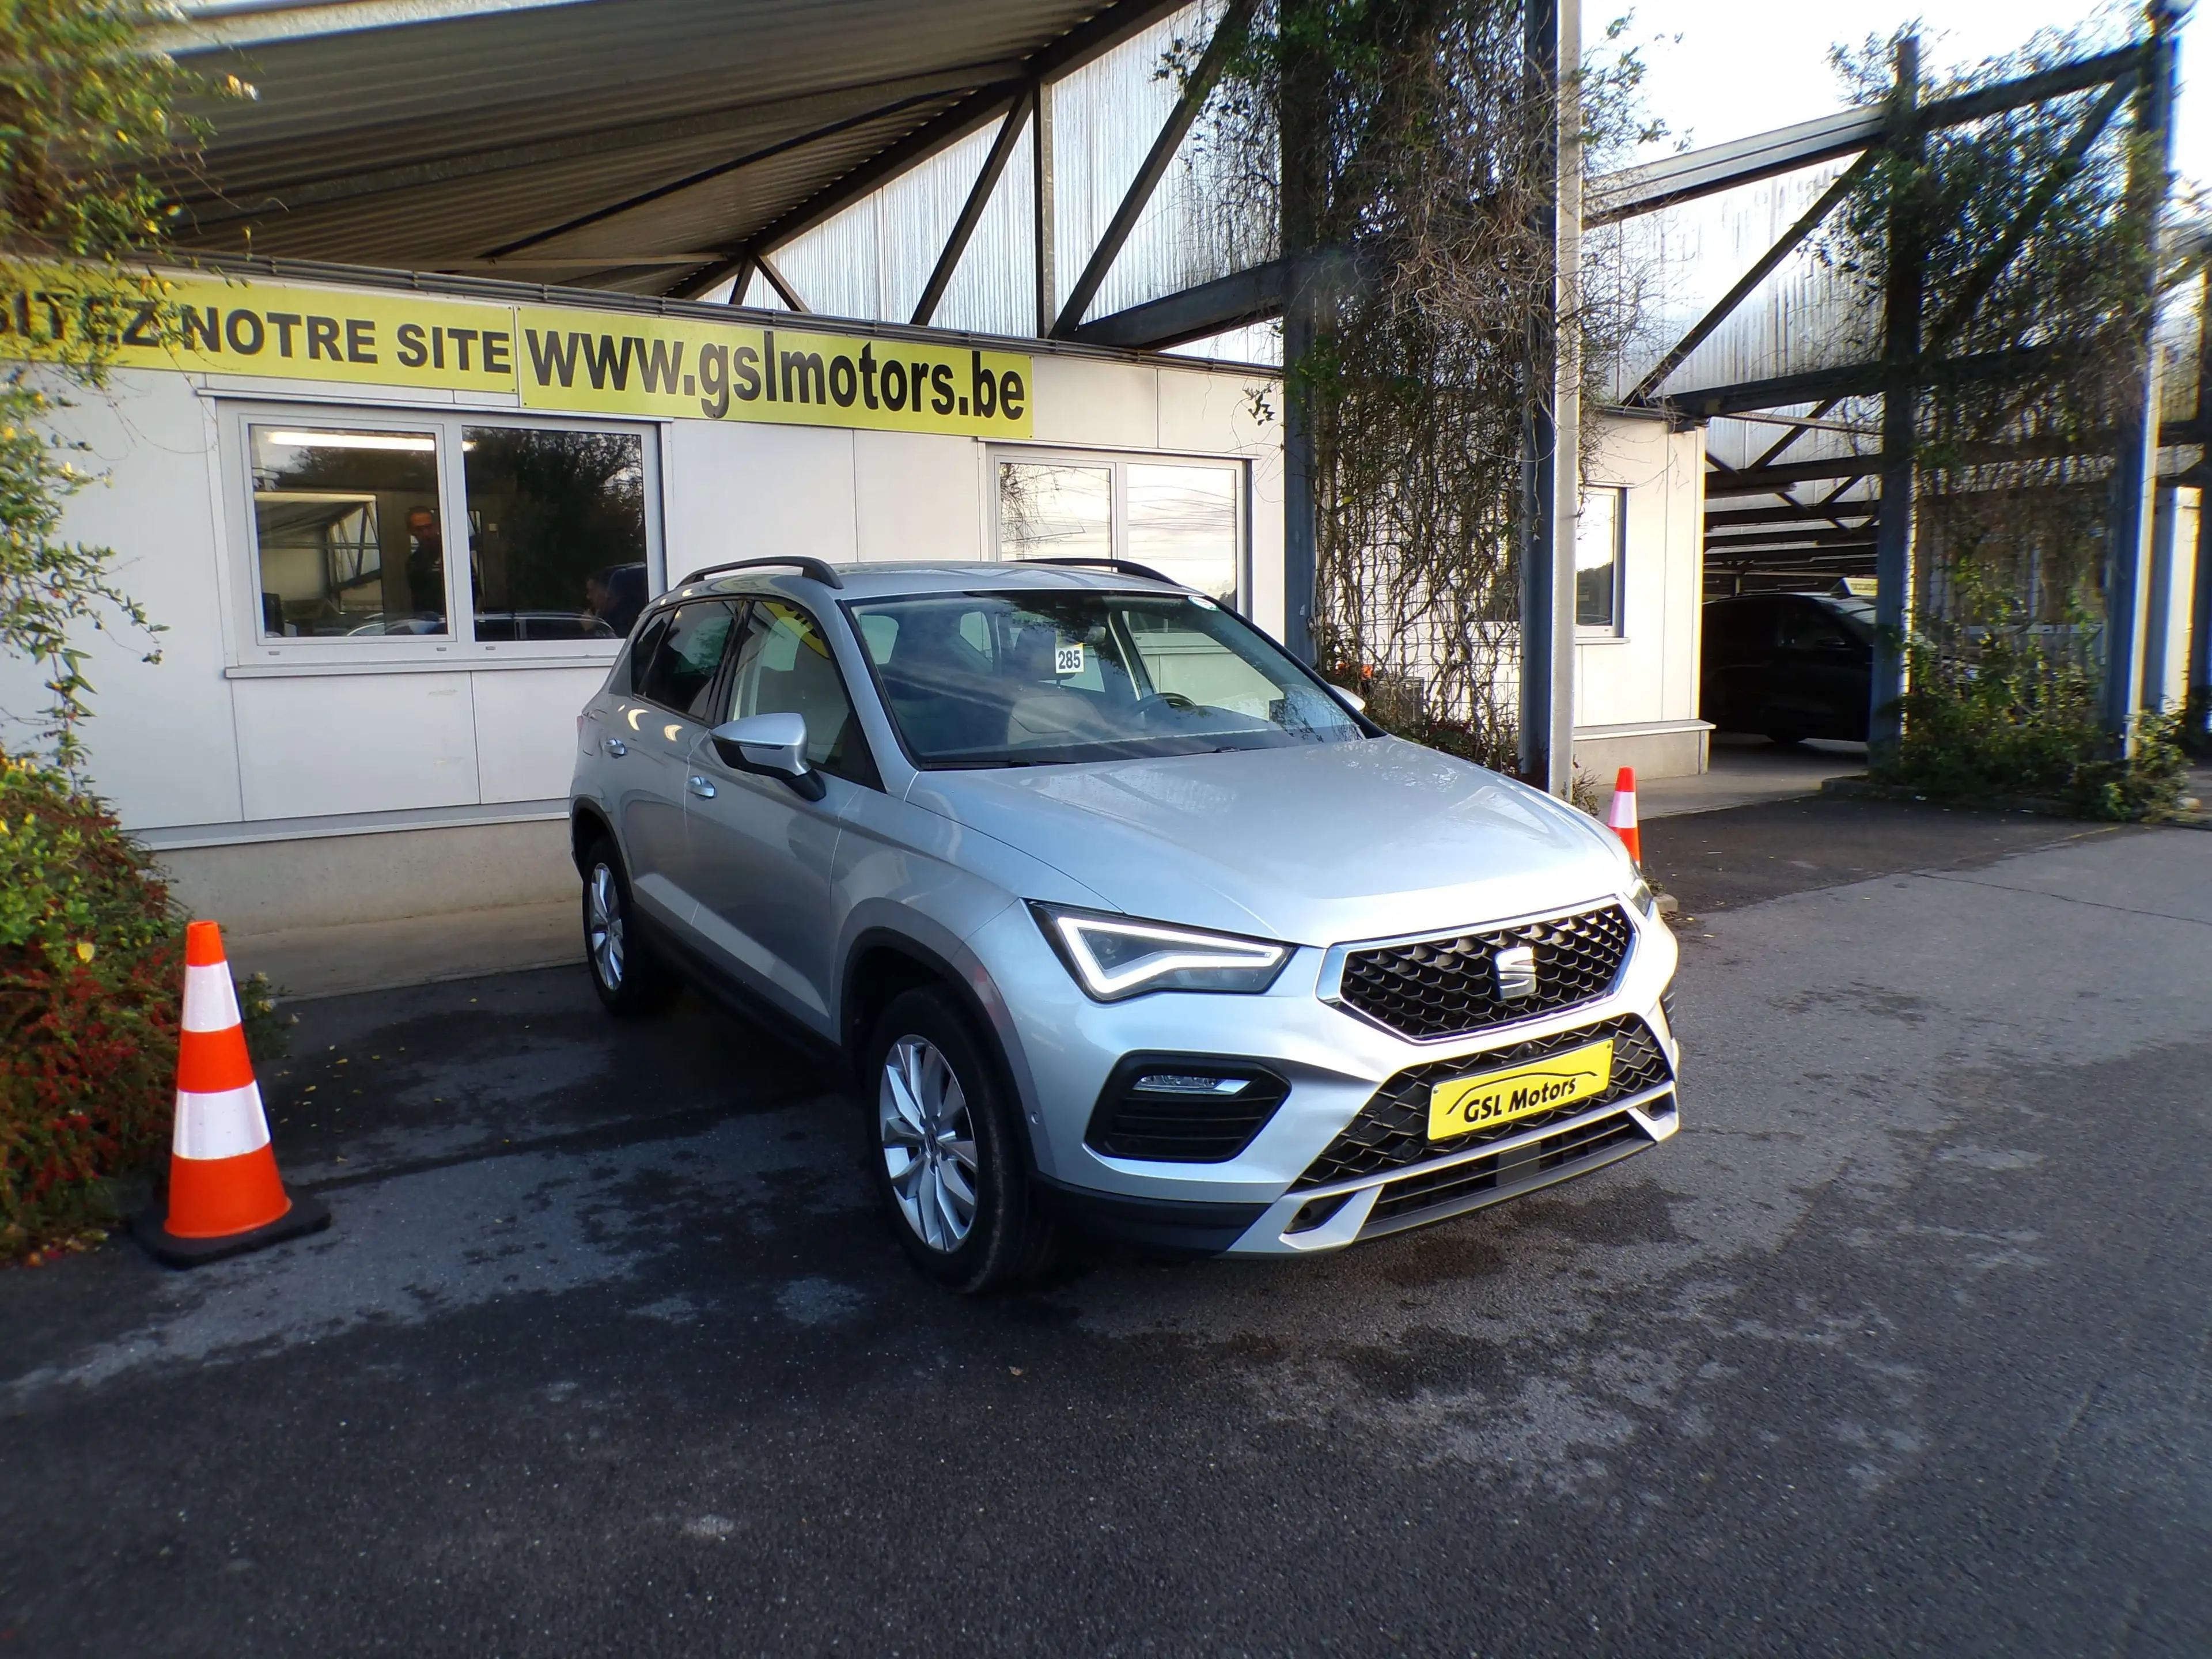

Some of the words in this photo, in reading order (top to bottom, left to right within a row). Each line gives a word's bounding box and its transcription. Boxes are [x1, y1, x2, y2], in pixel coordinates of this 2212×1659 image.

[180, 304, 378, 365] NOTRE
[396, 323, 512, 374] SITE
[525, 329, 1025, 420] www.gslmotors.be
[1058, 650, 1081, 669] 285
[1464, 1094, 1502, 1123] GSL
[1508, 1077, 1576, 1113] Motors
